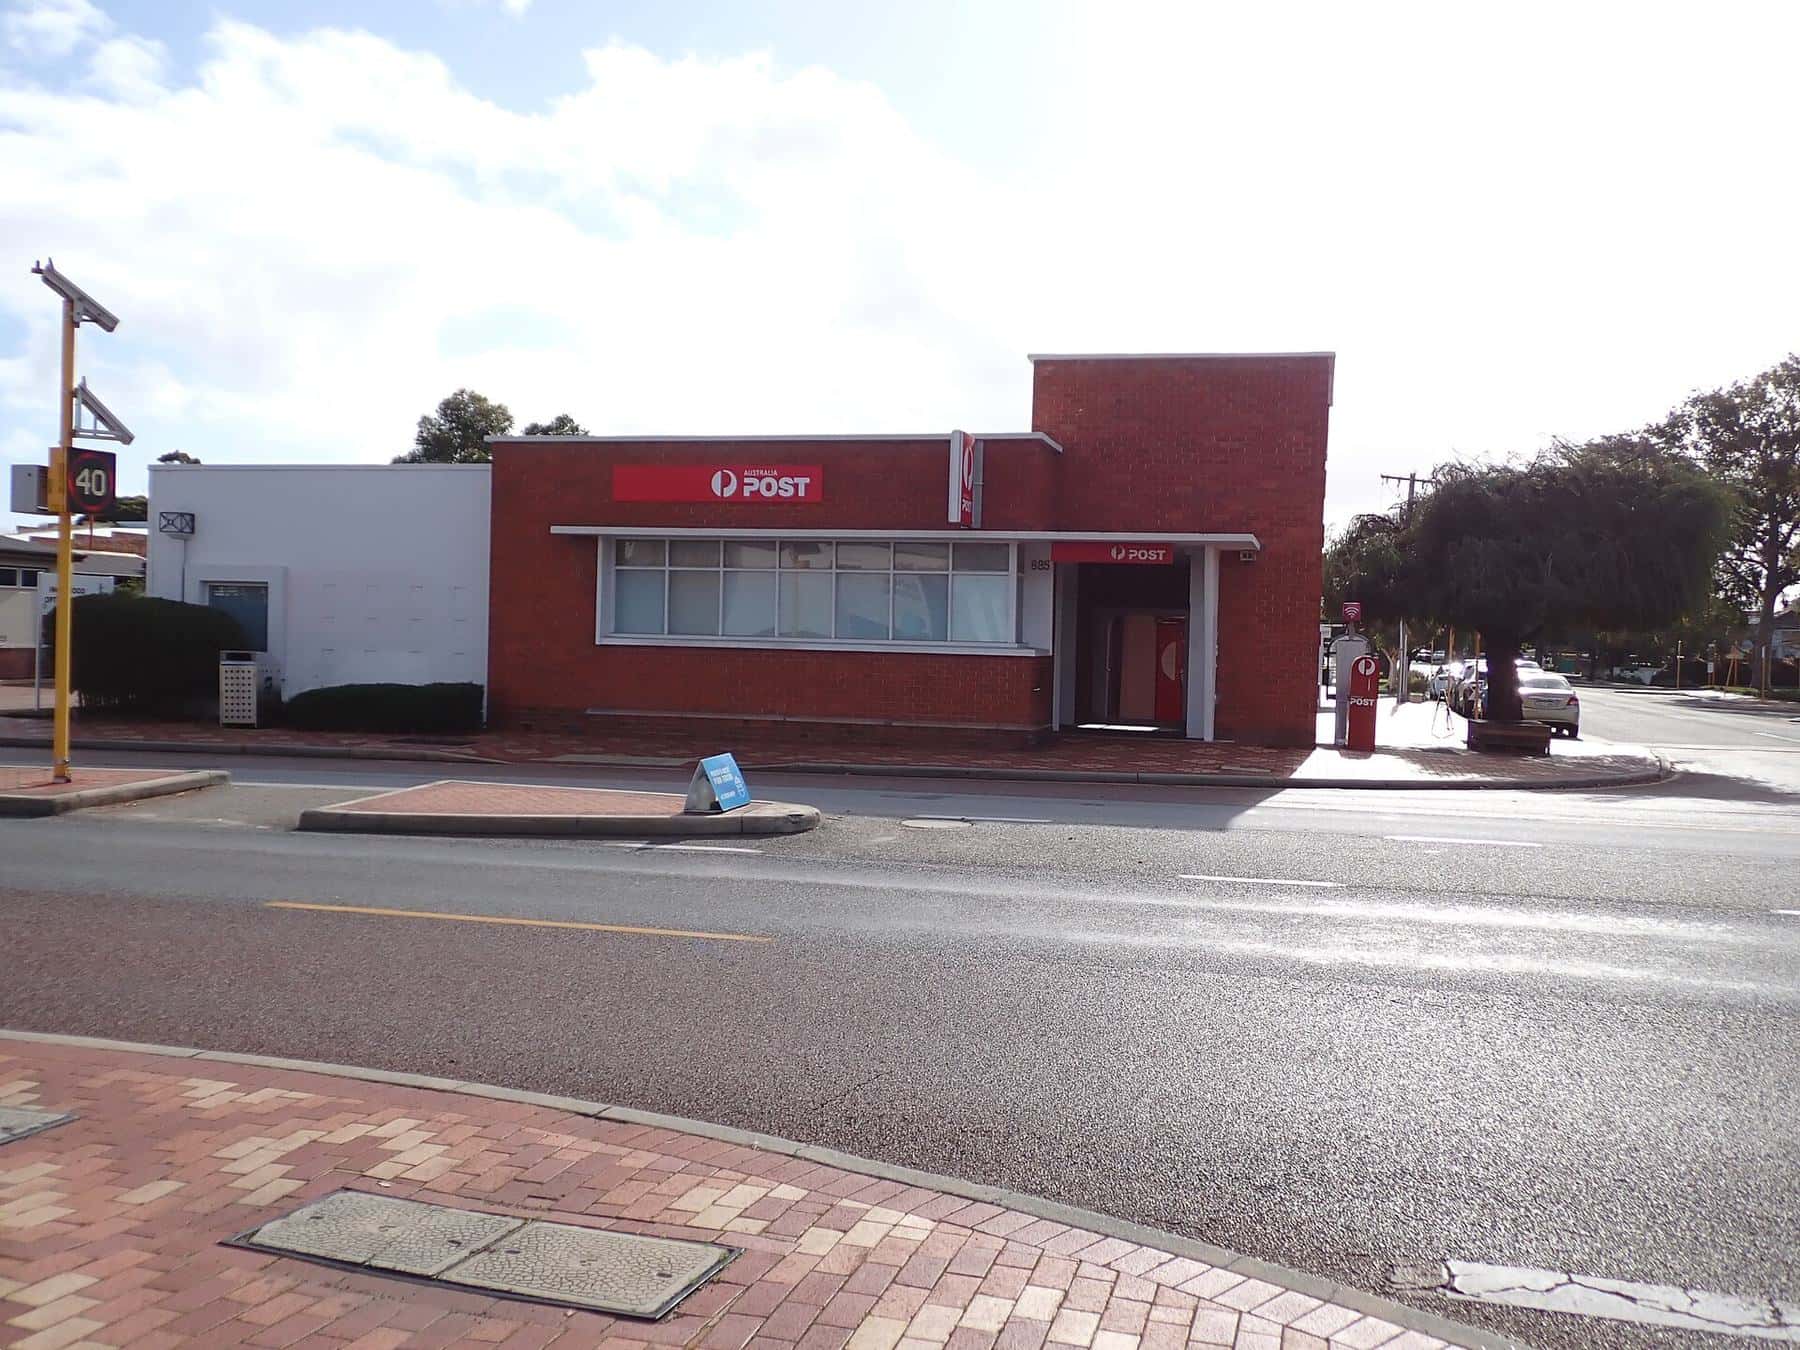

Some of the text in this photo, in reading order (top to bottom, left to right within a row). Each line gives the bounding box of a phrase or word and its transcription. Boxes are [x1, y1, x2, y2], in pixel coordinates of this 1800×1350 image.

[75, 468, 106, 496] 40
[743, 477, 810, 497] POST
[1128, 549, 1167, 560] POST
[1350, 697, 1375, 707] POST
